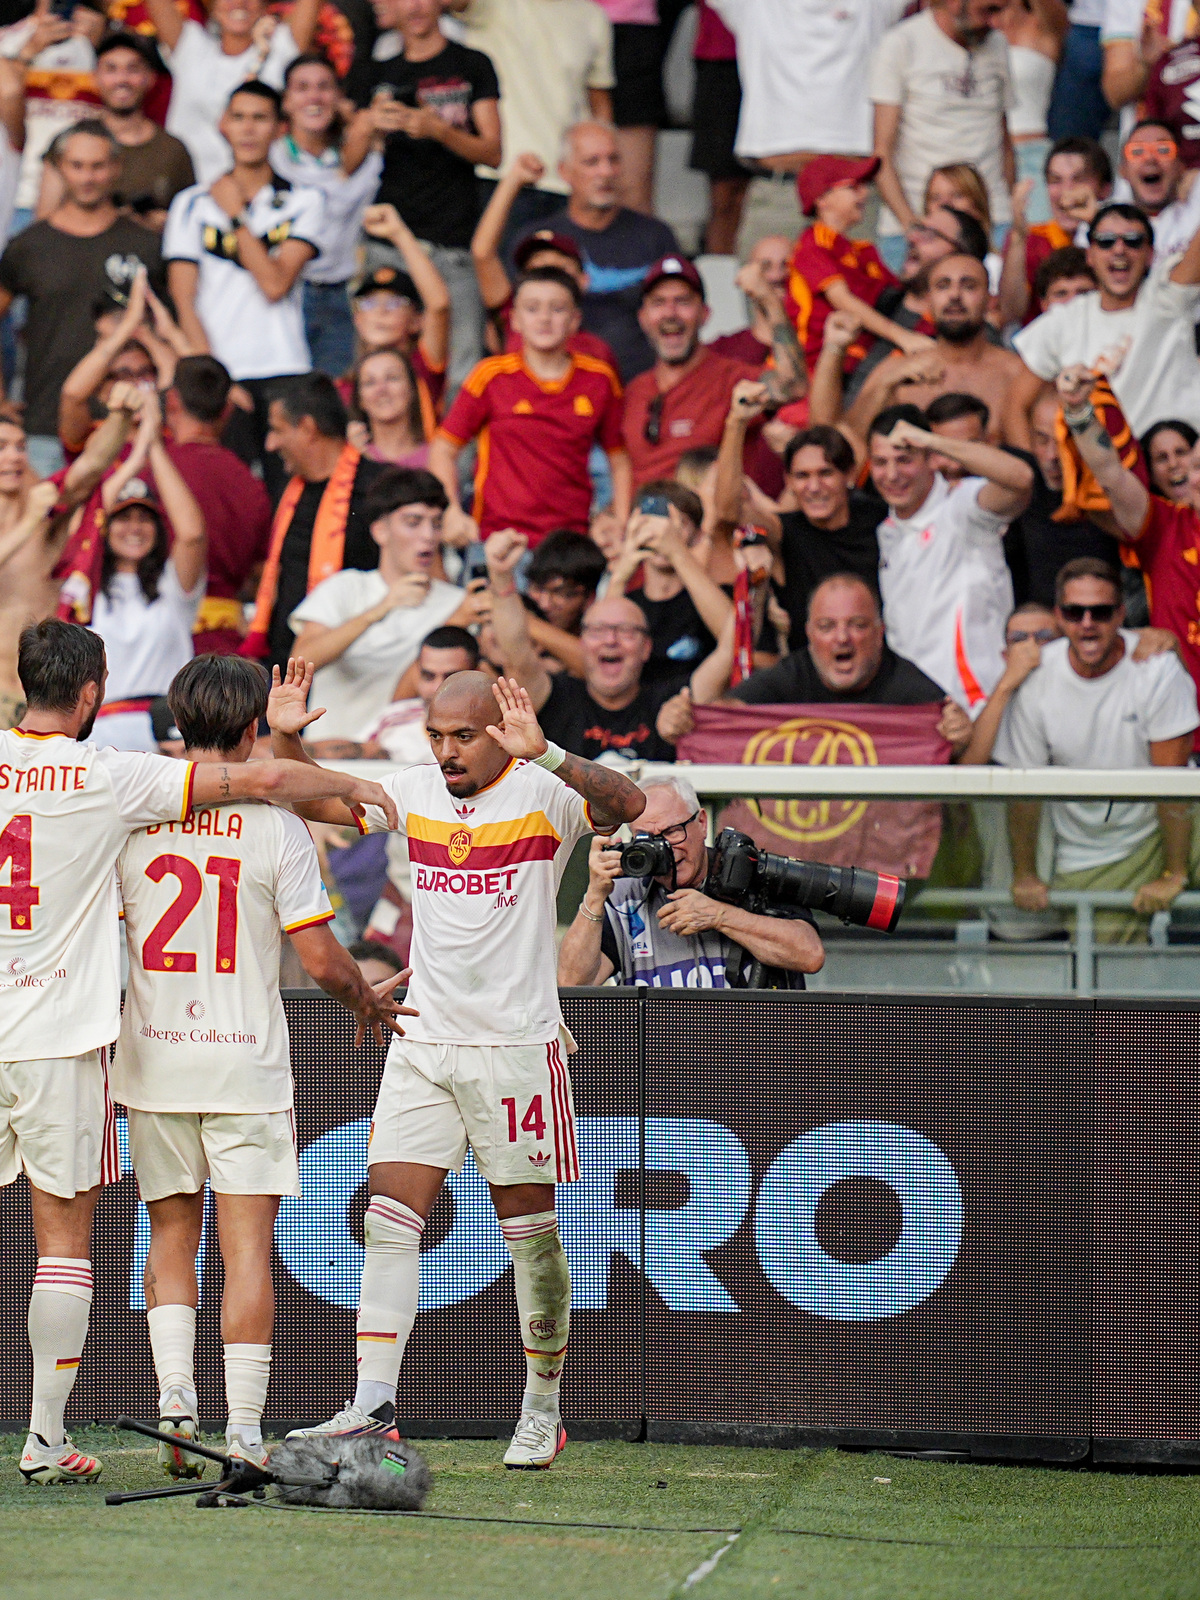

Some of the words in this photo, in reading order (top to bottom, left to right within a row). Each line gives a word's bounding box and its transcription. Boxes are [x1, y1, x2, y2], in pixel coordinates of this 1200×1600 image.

[416, 868, 518, 895] EUROBET
[142, 853, 241, 973] 21
[189, 1028, 257, 1045] Collection
[501, 1094, 546, 1143] 14
